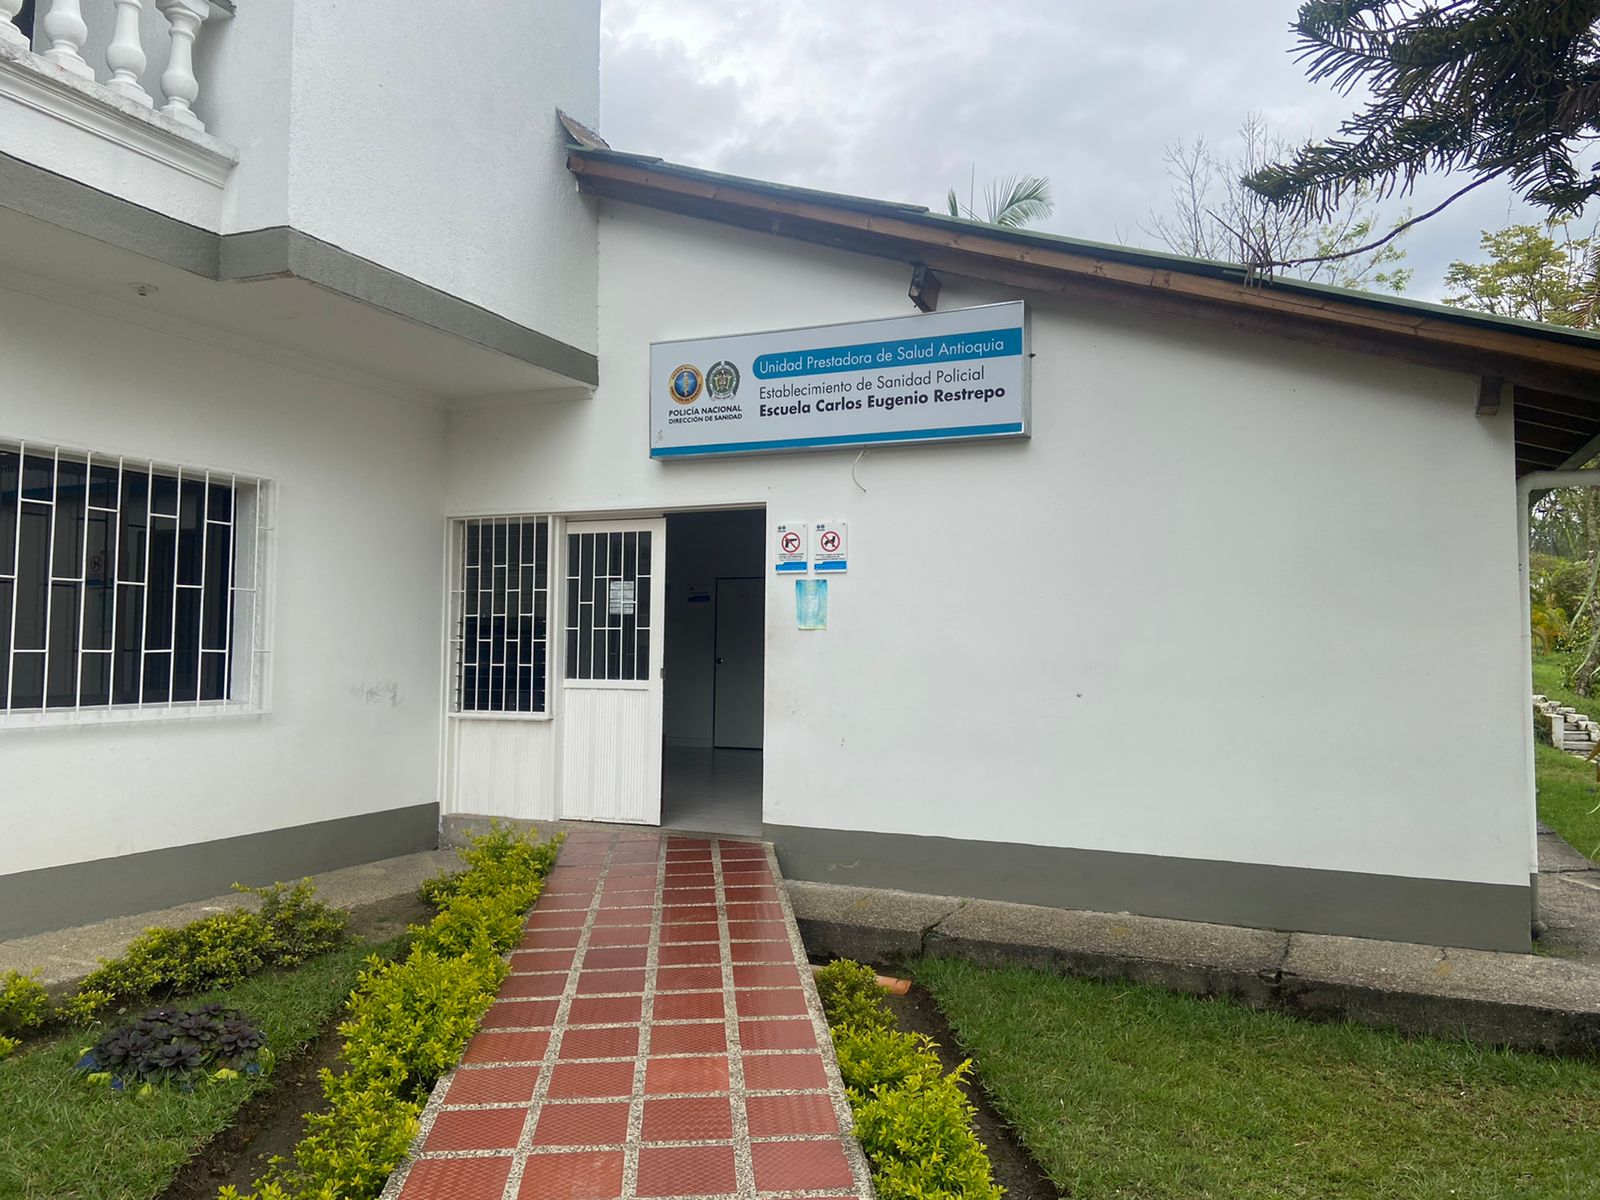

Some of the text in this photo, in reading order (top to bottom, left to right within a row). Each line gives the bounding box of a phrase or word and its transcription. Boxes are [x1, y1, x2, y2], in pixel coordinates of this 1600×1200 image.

[759, 338, 1004, 374] Unidad Prestadora de Salud Antioquia
[759, 365, 985, 400] Establecimiento de Sanidad Policial
[668, 405, 743, 417] POLICÍA NACIONAL
[759, 387, 1006, 417] Escuela Carlos Eugenio Restrepo
[668, 416, 704, 425] DIRECCIÓN
[714, 413, 743, 421] SANIDAD
